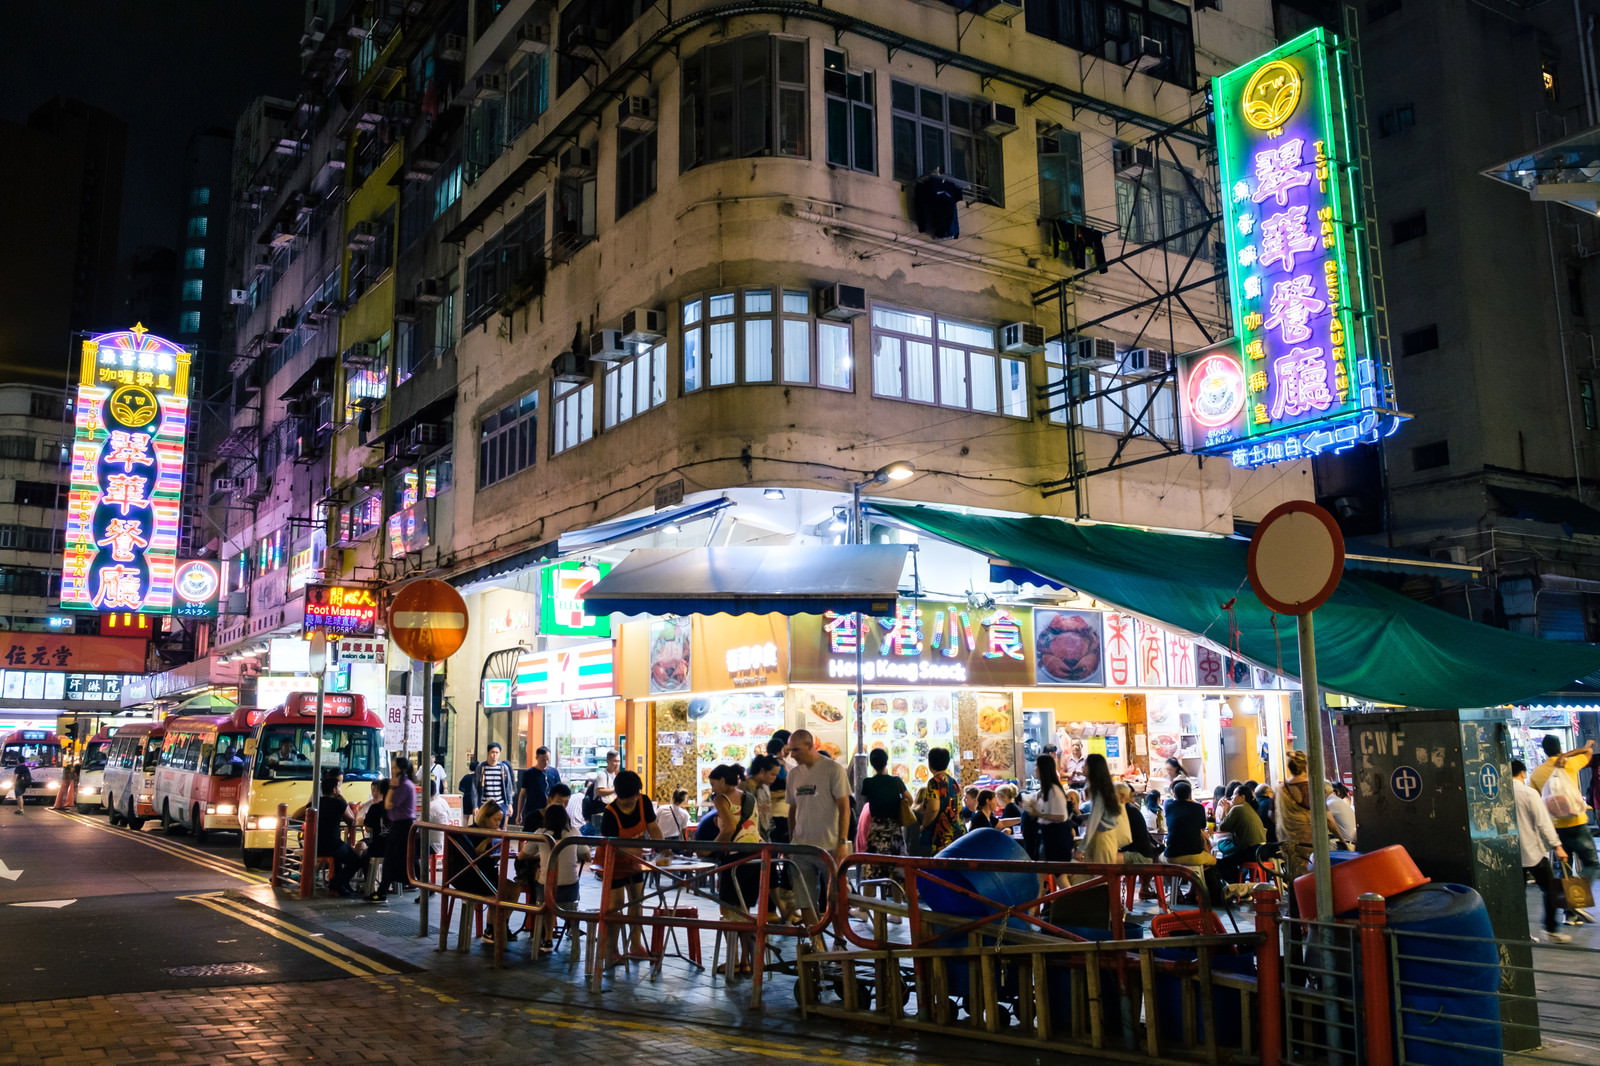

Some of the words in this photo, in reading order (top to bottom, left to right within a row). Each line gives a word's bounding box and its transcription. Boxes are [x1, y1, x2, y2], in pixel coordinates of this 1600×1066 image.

[1313, 140, 1328, 194] TSUI
[1317, 206, 1333, 249] WAH
[1252, 138, 1334, 420] 翠華餐廳
[1324, 260, 1347, 405] RESTAURANT
[87, 400, 98, 441] TSUI
[123, 395, 146, 405] TW
[82, 450, 97, 481] WAH
[94, 430, 154, 608] 翠華餐廳
[72, 490, 92, 598] RESTAURANT
[177, 608, 210, 616] レストラン
[307, 604, 329, 614] Foot
[331, 606, 373, 620] Massage
[330, 587, 376, 607] 開心人
[824, 604, 1024, 660] 香港小食
[829, 659, 875, 680] Hong
[876, 659, 918, 682] Kong
[919, 660, 966, 681] Snack
[1360, 731, 1405, 756] CWF
